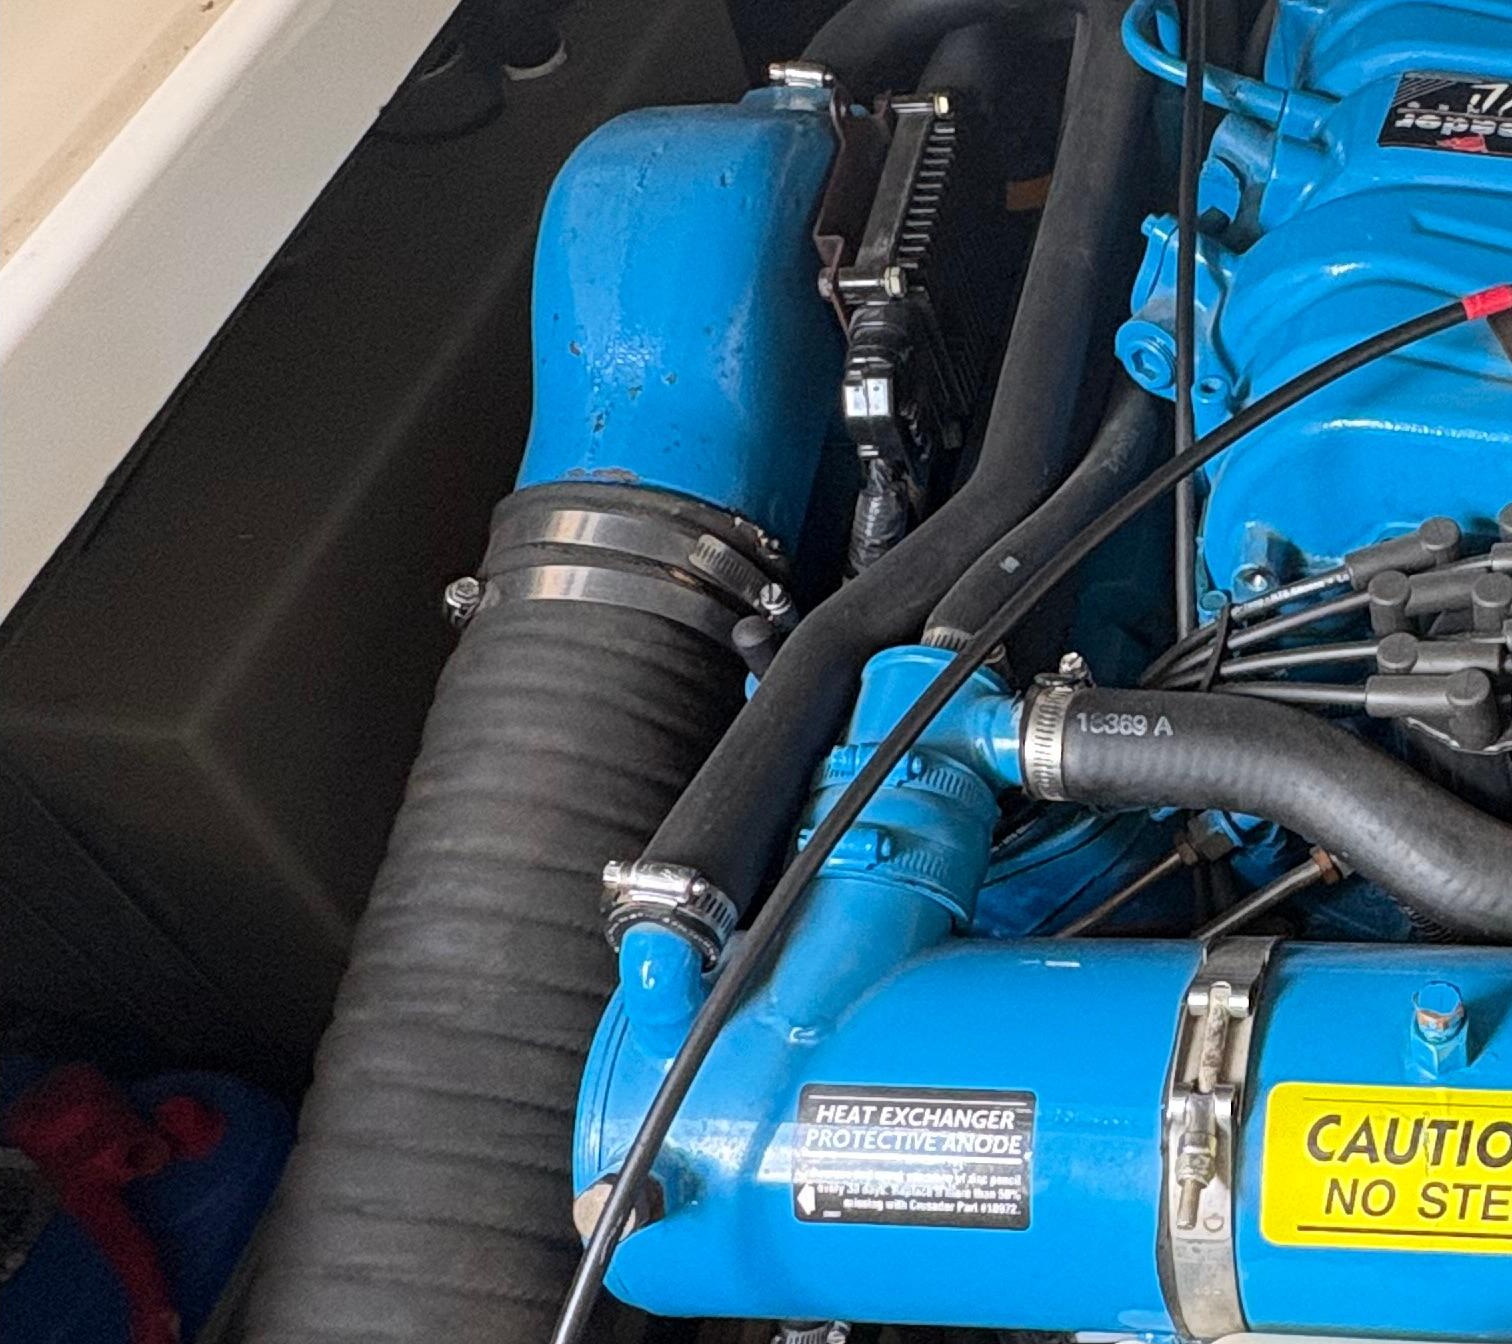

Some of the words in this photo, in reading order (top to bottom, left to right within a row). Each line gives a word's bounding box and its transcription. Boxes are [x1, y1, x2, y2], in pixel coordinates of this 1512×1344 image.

[1153, 716, 1173, 736] A
[815, 1103, 878, 1125] HEAT
[879, 1105, 1015, 1130] EXCHANGER
[804, 1127, 937, 1151] PROTECTIVE
[941, 1132, 1023, 1154] ANODE
[956, 1200, 979, 1212] Part
[1324, 1178, 1395, 1217] NO
